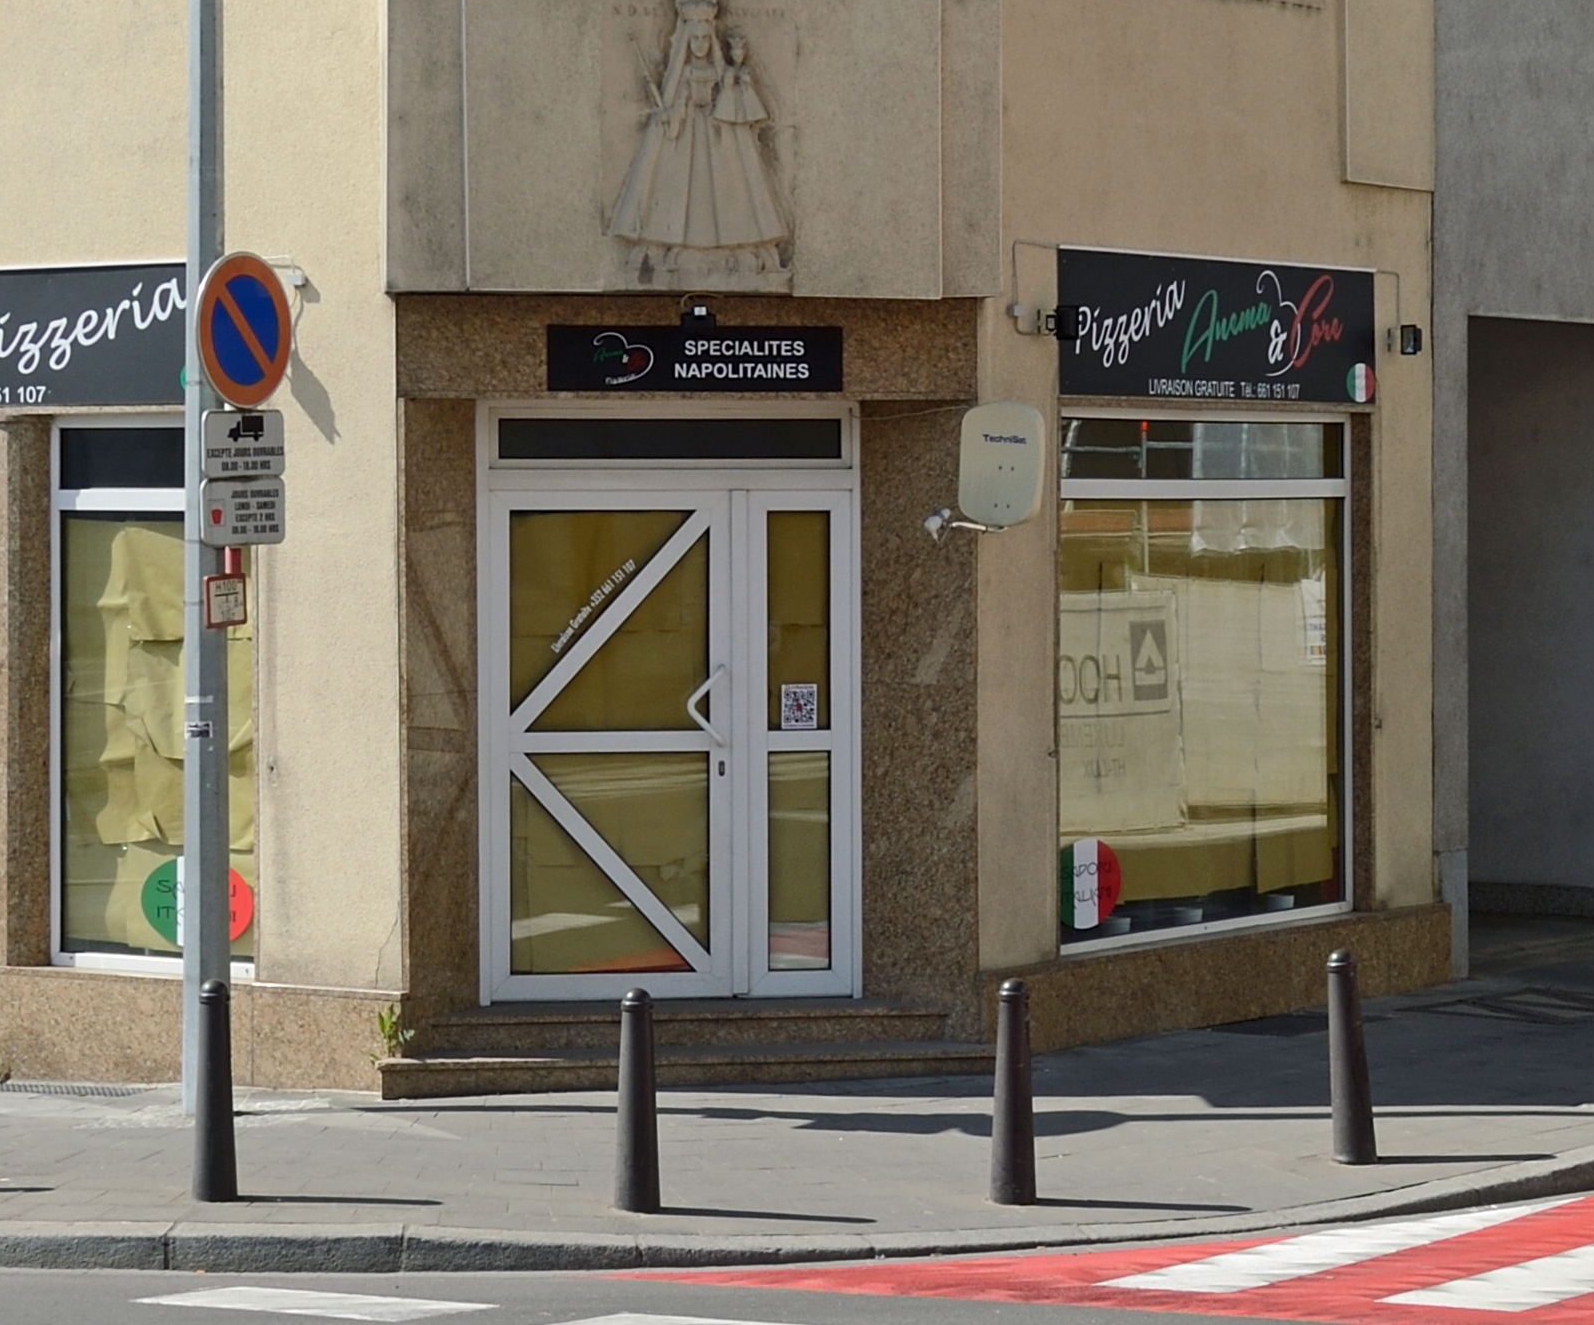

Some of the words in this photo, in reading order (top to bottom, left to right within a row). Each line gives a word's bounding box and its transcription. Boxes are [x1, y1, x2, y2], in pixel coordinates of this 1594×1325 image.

[1181, 289, 1272, 374] Anema
[1267, 319, 1287, 364] &
[1290, 274, 1344, 368] Core
[684, 340, 805, 356] SPECIALITES
[674, 363, 809, 379] NAPOLITAINES
[17, 386, 46, 403] 107
[1148, 378, 1193, 395] LIVRAISON
[1195, 379, 1235, 397] GRATUITE
[1257, 383, 1271, 399] 661
[1272, 383, 1286, 399] 151
[1287, 384, 1300, 400] 107
[207, 448, 232, 458] EXCEPTE
[233, 447, 251, 457] JOURS
[259, 460, 271, 469] HRS
[235, 513, 257, 522] EXCEPTE
[611, 569, 626, 584] 151
